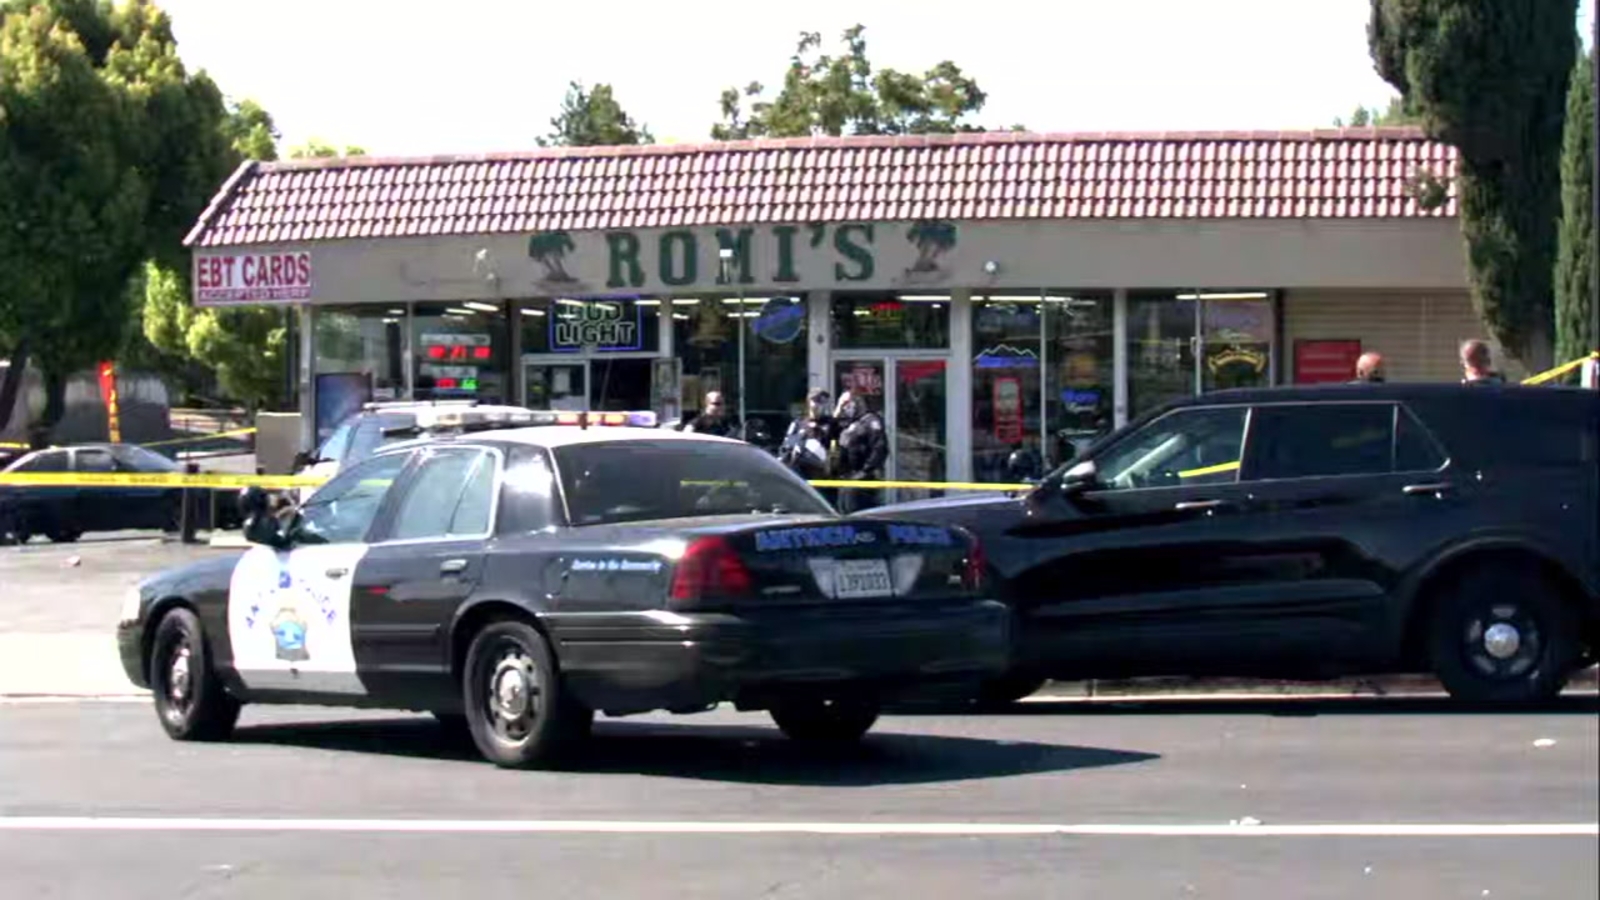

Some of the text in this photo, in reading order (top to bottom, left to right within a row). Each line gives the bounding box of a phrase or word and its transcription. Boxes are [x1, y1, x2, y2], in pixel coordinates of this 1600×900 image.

[199, 253, 310, 287] EBT CARDS
[605, 223, 875, 288] ROMI'S
[556, 320, 635, 345] LIGHT
